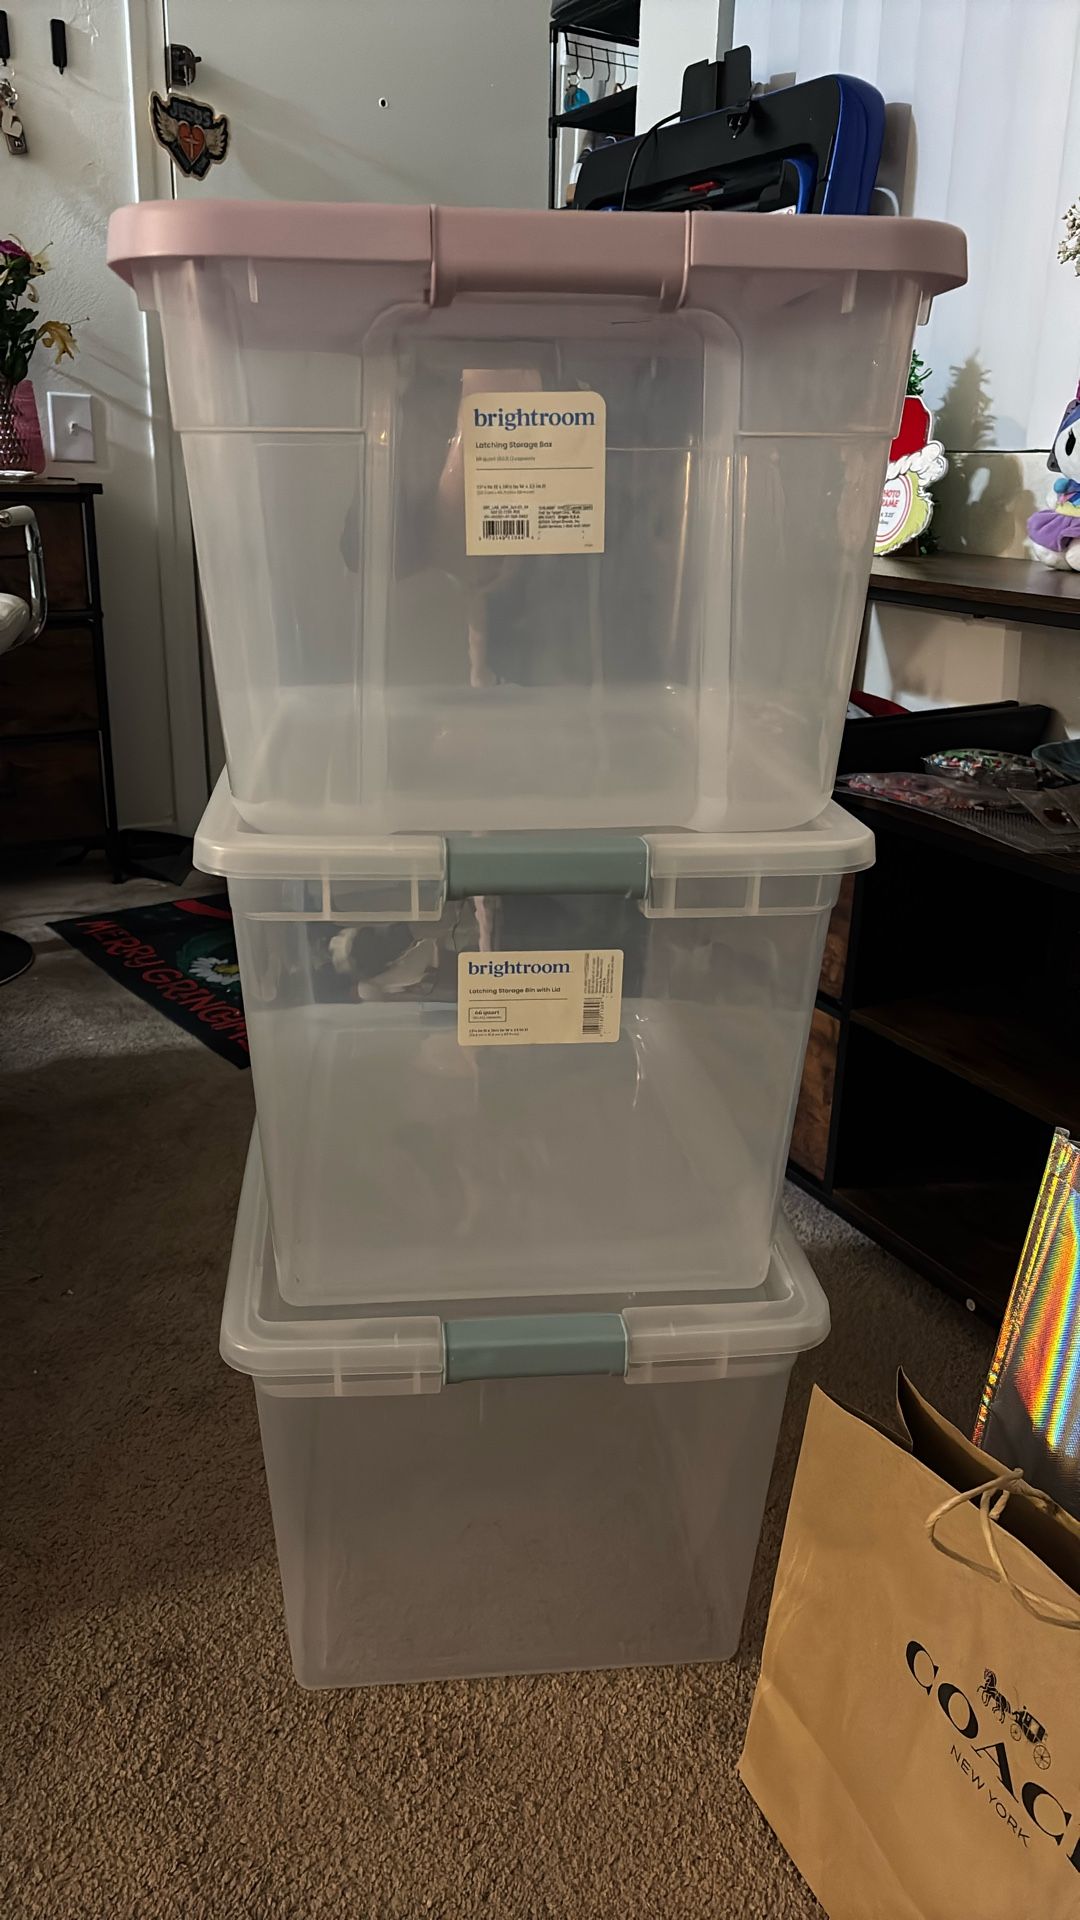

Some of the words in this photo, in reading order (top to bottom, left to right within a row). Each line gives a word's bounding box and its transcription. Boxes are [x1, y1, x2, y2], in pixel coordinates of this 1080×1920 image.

[169, 101, 212, 126] JESUS
[474, 408, 595, 431] brightroom
[475, 441, 508, 450] Latching
[509, 441, 538, 450] Storage
[75, 920, 165, 968] MERRY
[468, 961, 570, 978] brightroom
[950, 1745, 985, 1790] NEW
[988, 1789, 1030, 1848] YORK
